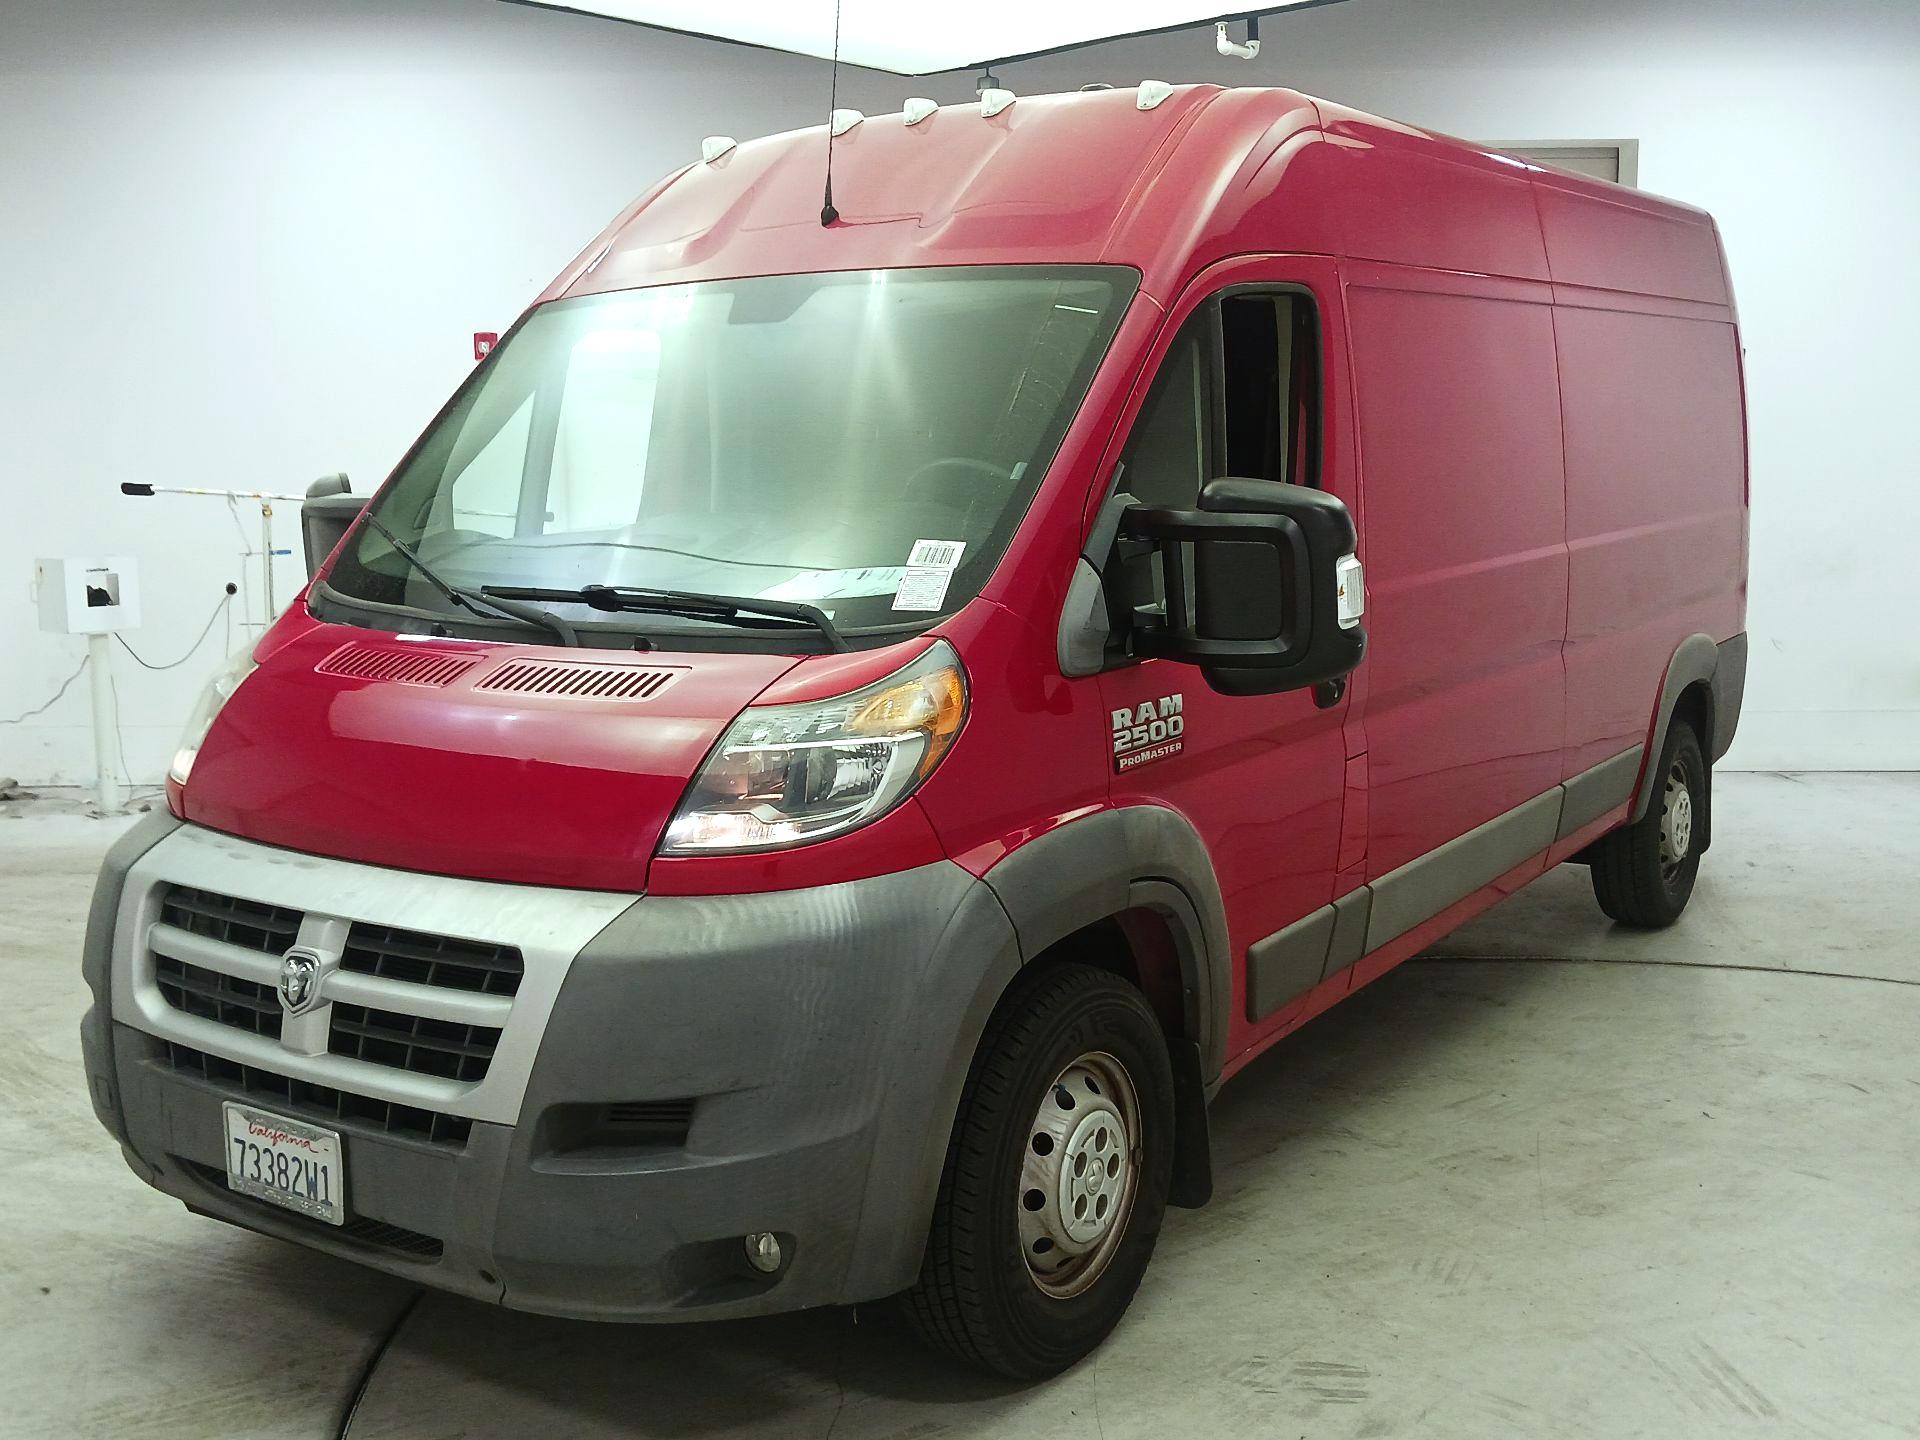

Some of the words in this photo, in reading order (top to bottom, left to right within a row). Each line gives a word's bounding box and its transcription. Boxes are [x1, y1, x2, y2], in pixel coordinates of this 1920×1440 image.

[1111, 693, 1183, 731] RAM
[1113, 715, 1184, 753] 2500
[248, 1119, 319, 1154] California
[233, 1137, 333, 1207] 73382W1
